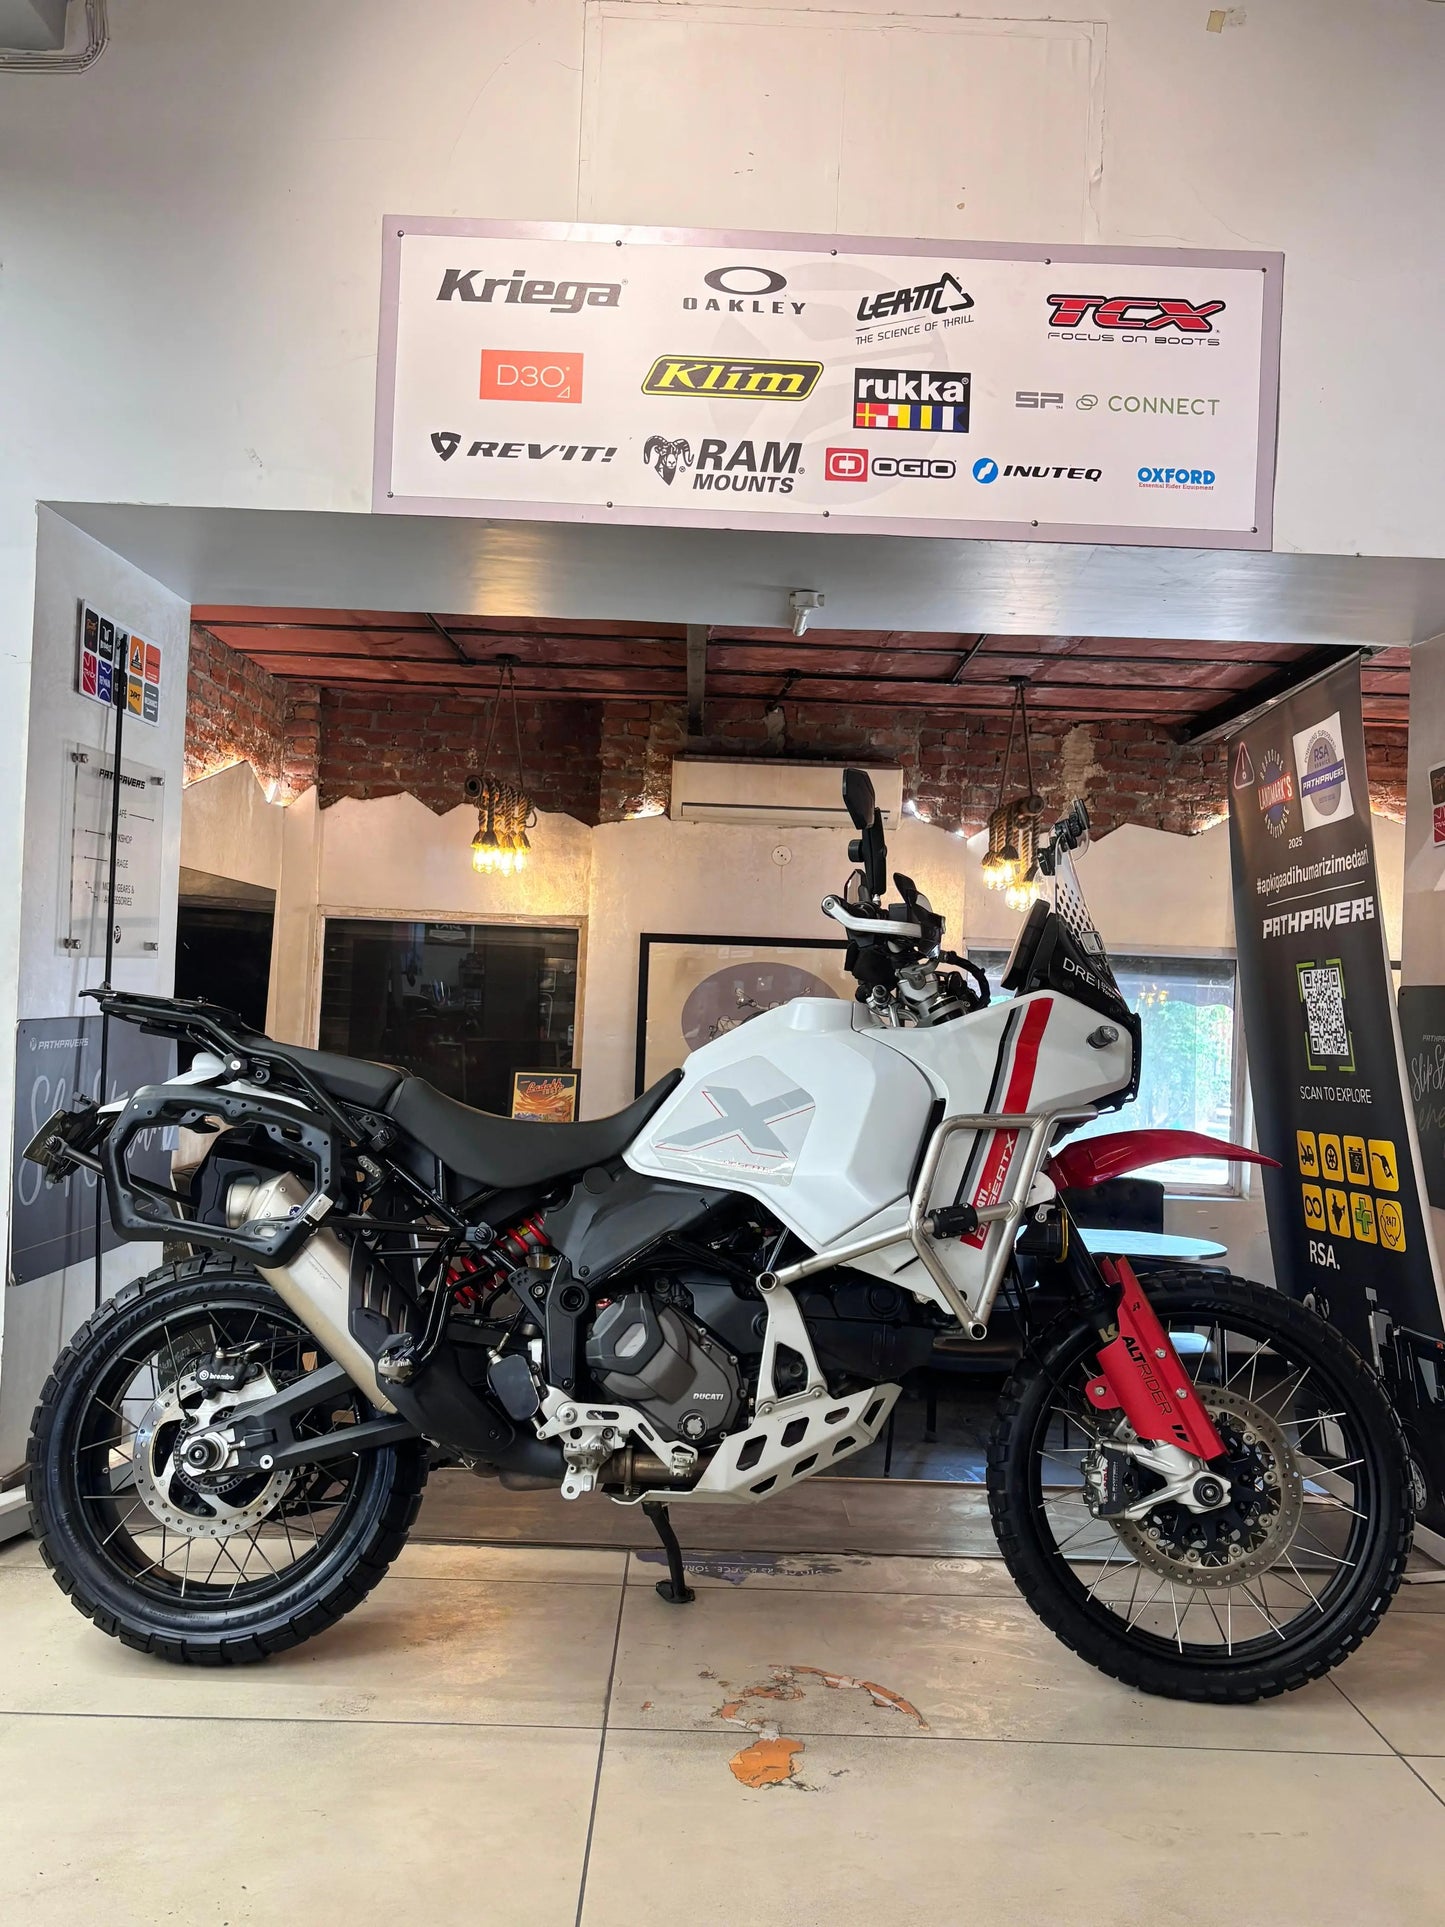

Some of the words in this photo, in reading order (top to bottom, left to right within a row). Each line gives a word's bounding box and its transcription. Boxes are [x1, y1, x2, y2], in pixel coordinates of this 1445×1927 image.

[436, 268, 623, 314] Kriega
[682, 297, 807, 315] OAKLEY
[1047, 293, 1227, 333] TCX
[855, 334, 874, 345] THE
[877, 324, 921, 342] SCIENCE
[924, 321, 938, 332] OF
[942, 315, 975, 330] THRILL
[1047, 332, 1115, 342] FOCUS
[1154, 337, 1221, 346] BOOTS
[652, 362, 806, 394] Klim
[858, 372, 964, 403] rukka
[1015, 391, 1064, 409] SP
[1108, 395, 1221, 416] CONNECT
[465, 440, 619, 463] REV'IT!
[696, 438, 803, 474] RAM
[871, 457, 957, 480] OGIO
[1002, 464, 1102, 483] INUTEQ
[1137, 467, 1216, 485] OXFORD
[692, 473, 795, 494] MOUNTS
[1313, 744, 1330, 762] RSA
[99, 768, 146, 790] PATPAVERS
[1302, 766, 1344, 791] PATHPAVERS
[1258, 775, 1293, 811] LANDMARK'S
[1288, 836, 1304, 850] 2025
[1262, 895, 1376, 940] PATHPAVERS
[1062, 957, 1096, 987] DRE
[37, 1037, 90, 1050] PATHPAVERS
[1299, 1085, 1323, 1101] SCAN
[1323, 1086, 1335, 1102] TO
[1336, 1087, 1373, 1104] EXPLORE
[1309, 1240, 1341, 1271] RSA.
[209, 1372, 235, 1380] brembo
[1120, 1335, 1173, 1416] ALTRIDER
[692, 1392, 724, 1401] DUCATI
